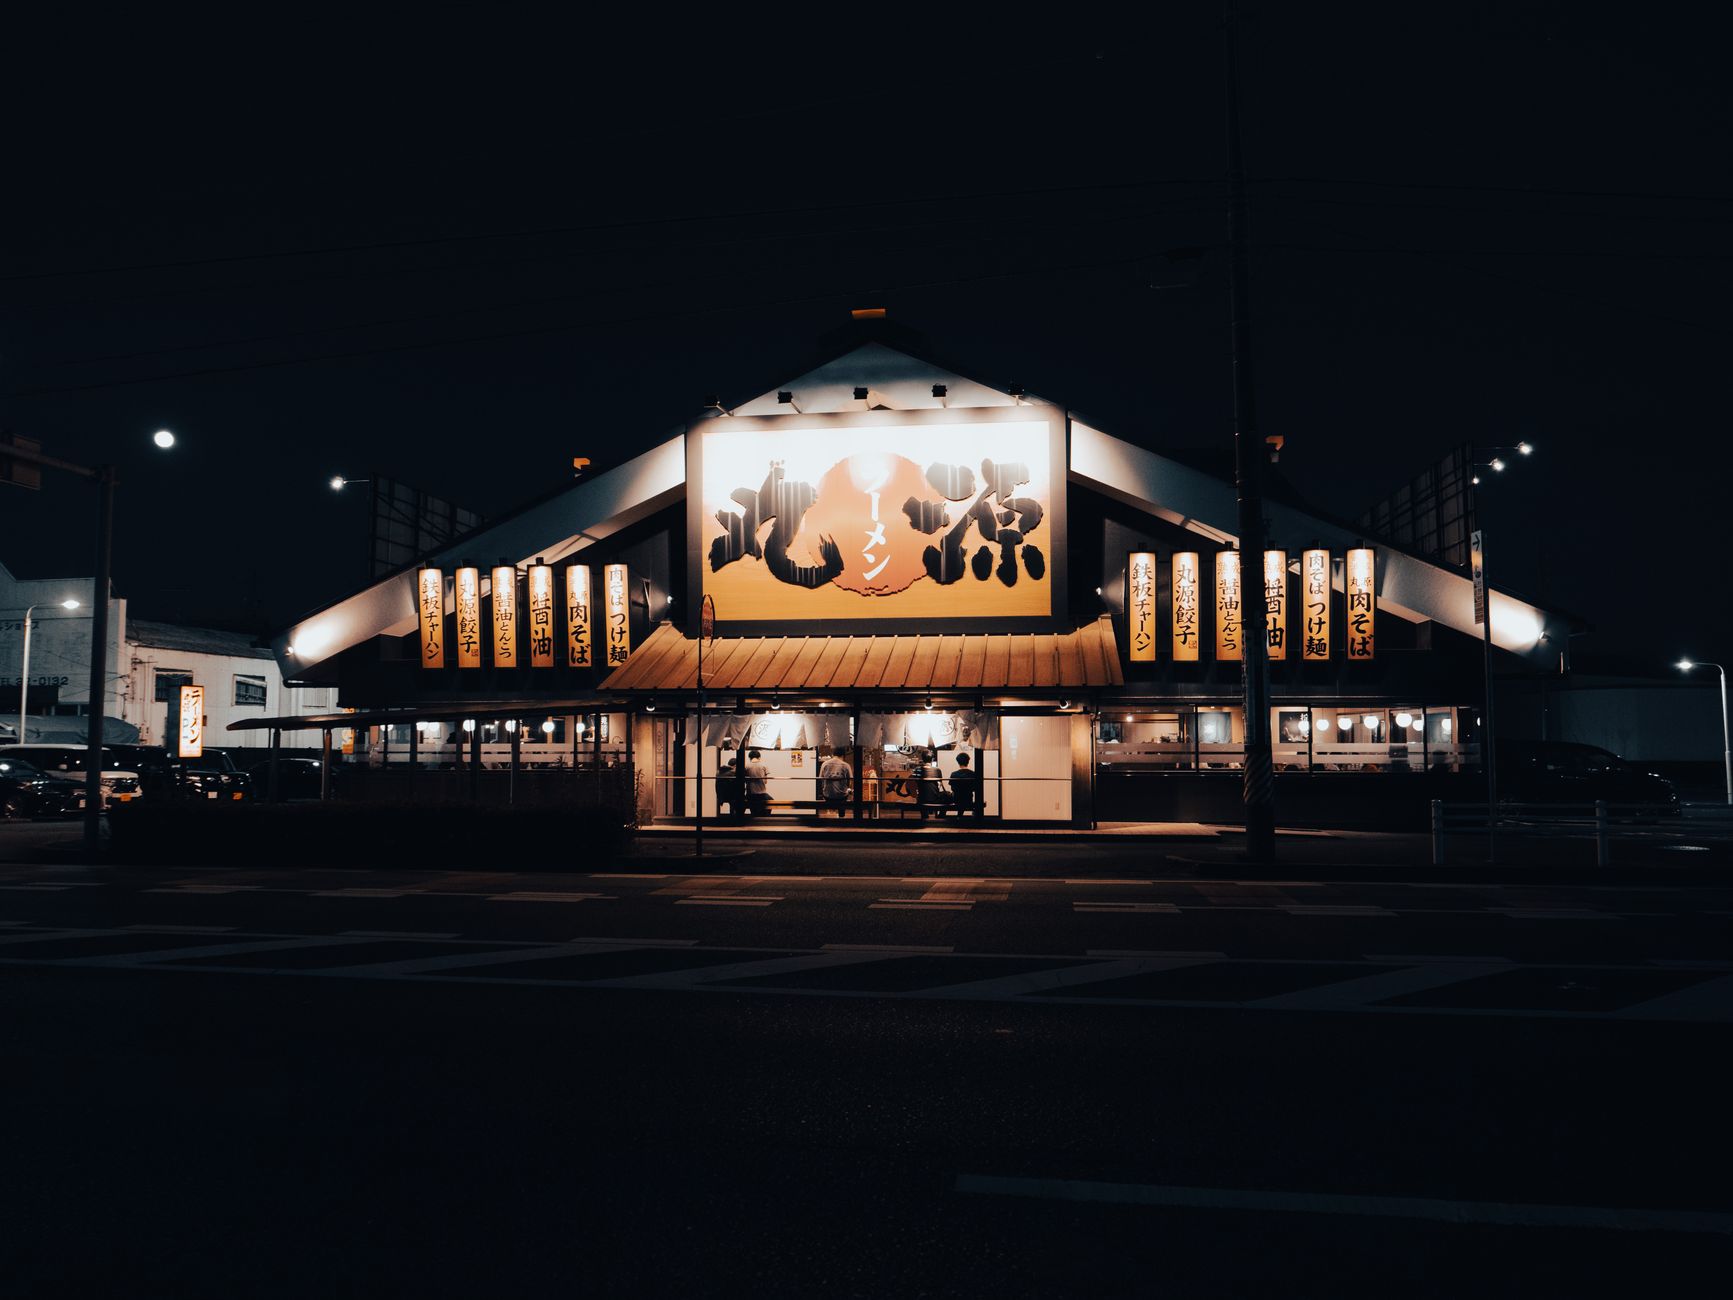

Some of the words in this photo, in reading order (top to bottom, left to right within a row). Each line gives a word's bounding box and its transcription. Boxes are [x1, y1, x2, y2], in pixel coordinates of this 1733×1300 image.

[422, 578, 440, 659] 鉄板チャーハン
[459, 579, 478, 654] 丸源餃子
[1132, 562, 1153, 652] 鉄板チャーハン
[1175, 564, 1196, 646] 丸源餃子
